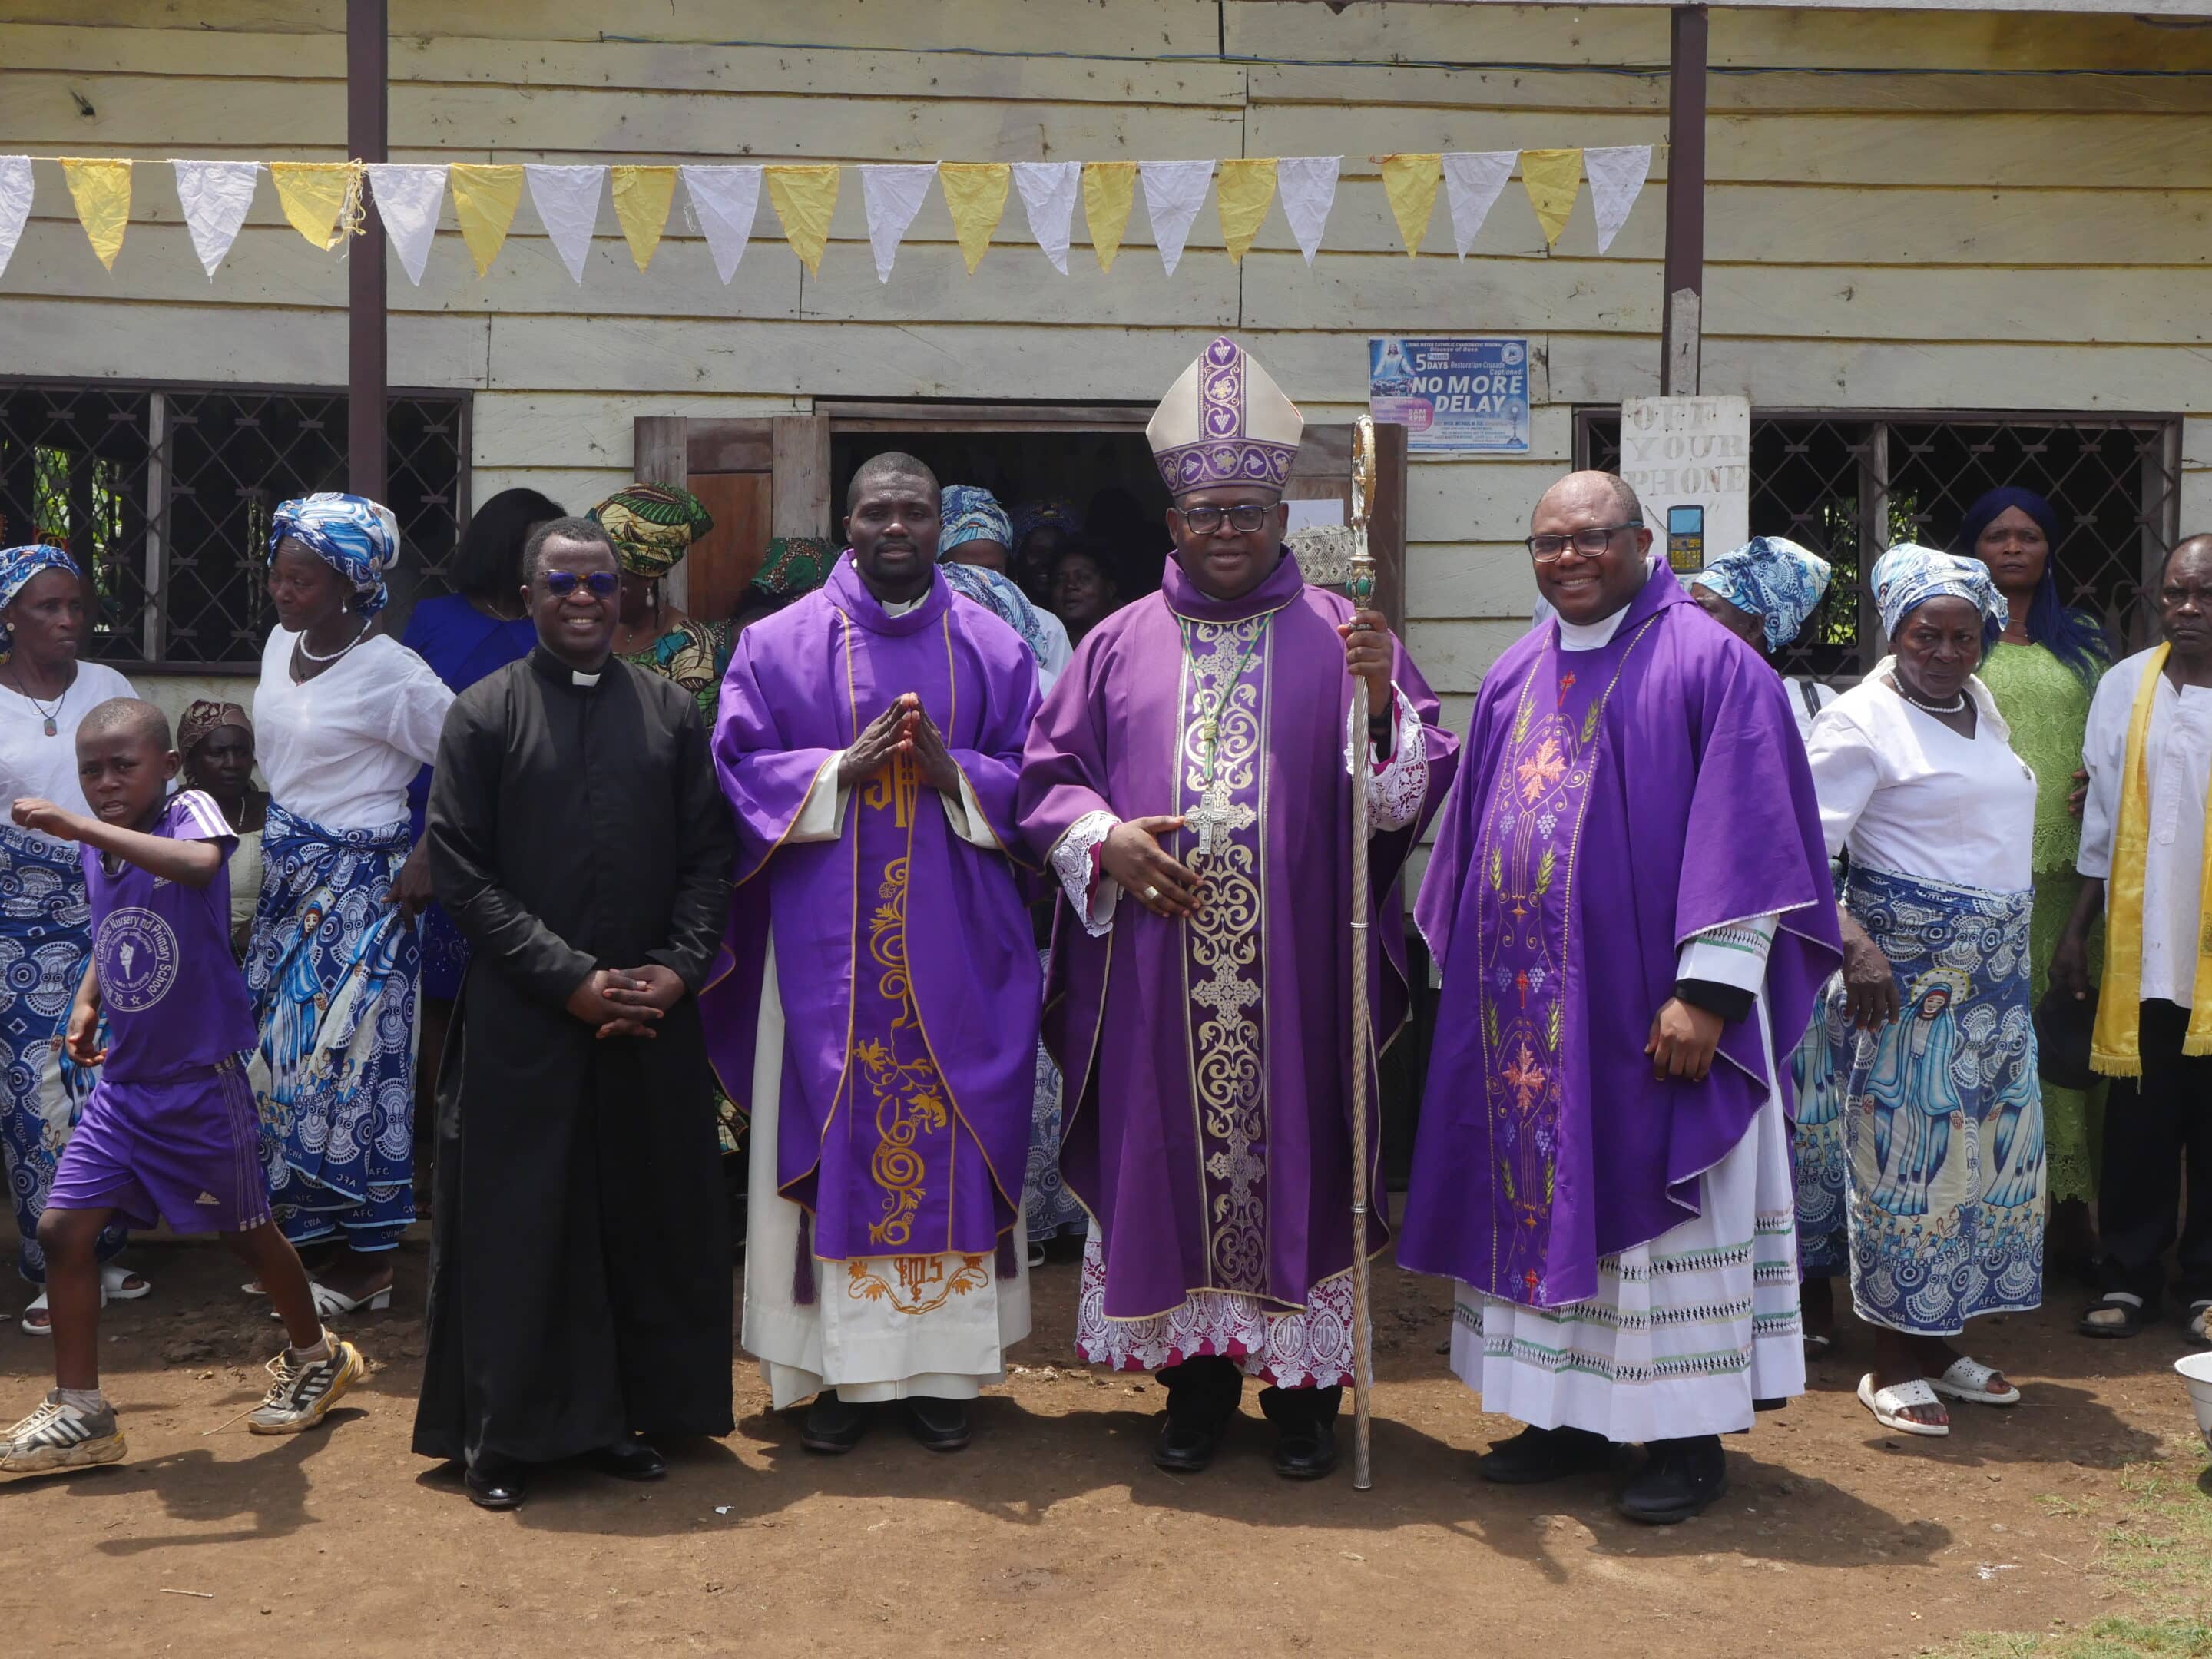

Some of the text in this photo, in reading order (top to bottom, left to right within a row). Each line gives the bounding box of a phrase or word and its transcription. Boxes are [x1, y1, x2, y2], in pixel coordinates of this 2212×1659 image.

[1416, 353, 1427, 371] 5
[1412, 376, 1523, 394] NO MORE
[1434, 395, 1506, 412] DELAY
[1626, 435, 1747, 462] YOUR
[1623, 465, 1746, 497] PHONE
[109, 916, 140, 930] Nursery
[97, 926, 112, 960] Catholic
[150, 923, 170, 962] Primary
[147, 963, 172, 998] School
[368, 1167, 389, 1177] AFC
[353, 1209, 374, 1218] AFC
[303, 1218, 322, 1229] CWA
[1979, 1296, 1997, 1306] AFC
[1887, 1309, 1906, 1323] CWA
[1939, 1318, 1958, 1327] AFC
